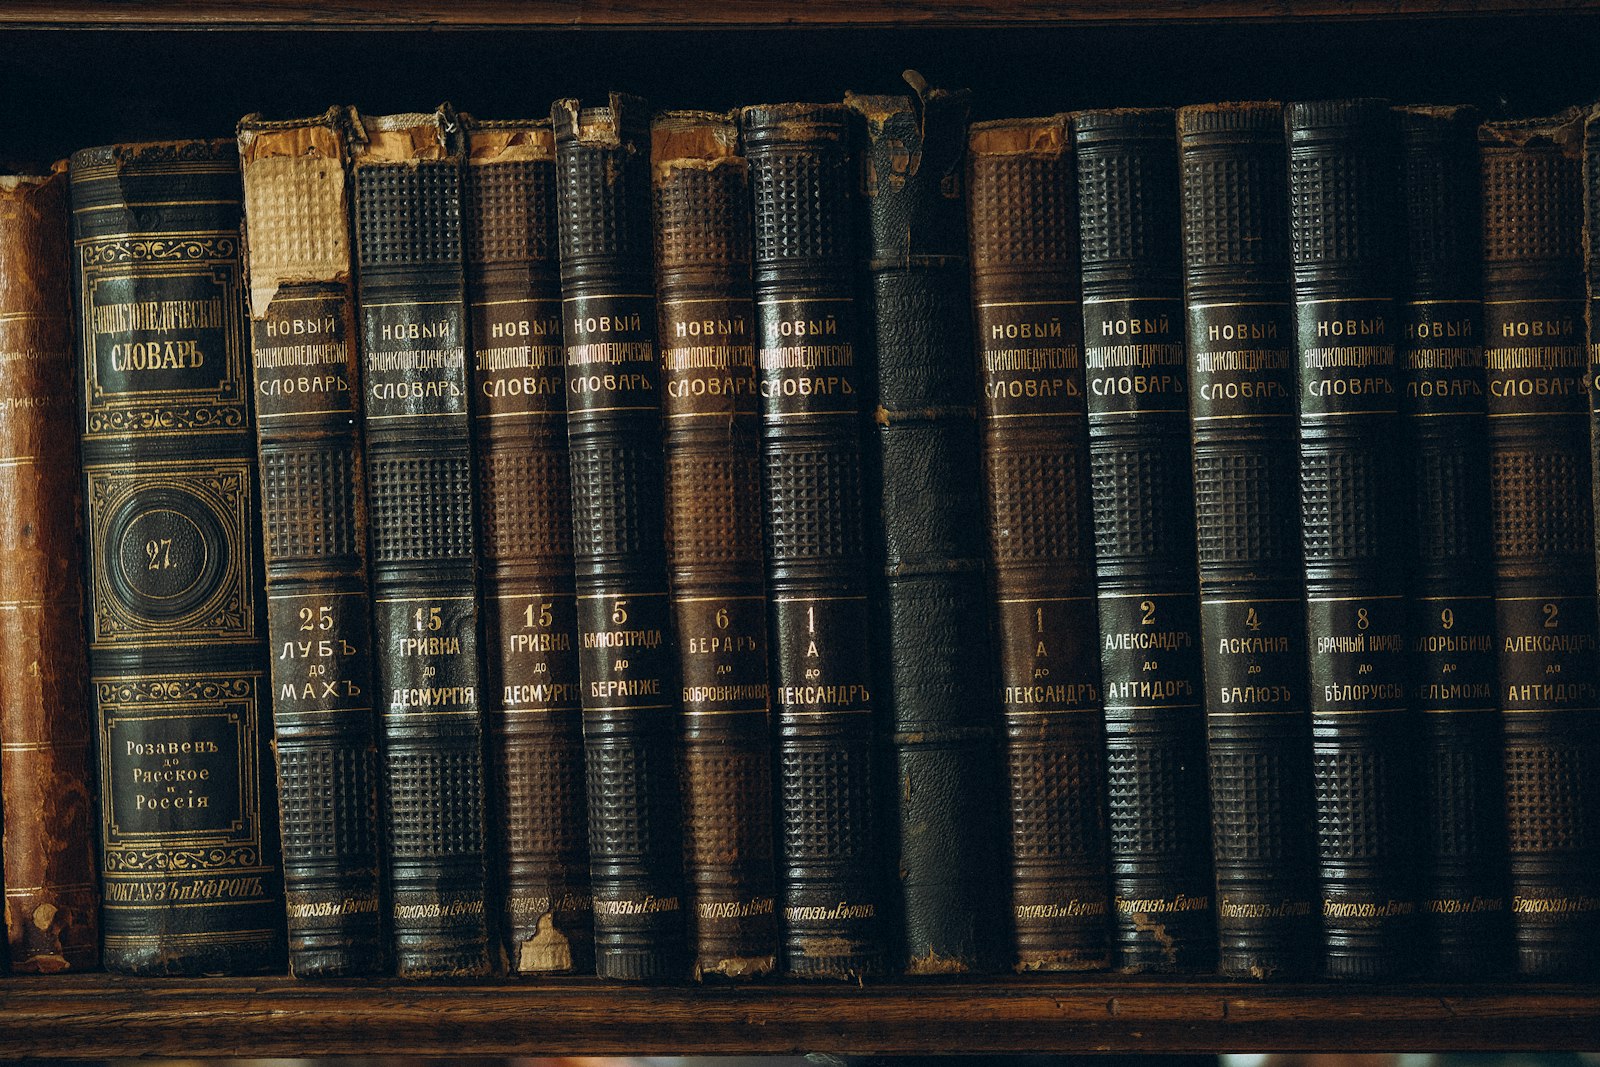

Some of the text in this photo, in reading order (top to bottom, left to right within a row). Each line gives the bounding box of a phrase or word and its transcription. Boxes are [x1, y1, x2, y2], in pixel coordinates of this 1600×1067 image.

[267, 315, 335, 337] НОВЫЙ
[382, 319, 449, 341] НОВЫЙ
[492, 316, 560, 338] НОВЫЙ
[574, 313, 641, 334] НОВЫЙ
[676, 314, 745, 338] НОВЫЙ
[768, 315, 837, 337] НОВЫЙ
[992, 317, 1061, 339] НОВЫЙ
[1103, 314, 1169, 336] НОВЫЙ
[1209, 320, 1277, 342] НОВЫЙ
[1317, 316, 1386, 337] НОВЫЙ
[1404, 319, 1473, 338] НОВЫЙ
[1503, 316, 1573, 338] НОВЫЙ
[112, 340, 204, 372] СЛОВАРЬ
[368, 346, 464, 373] ЭНЦИКЛОПЕДИЧЕСКІЙ
[758, 342, 854, 371] НЦИКЛОПЕДИЧЕСКІЙ
[1086, 341, 1184, 370] ЭНЦИКЛОПЕДИЧЕСКІЙ
[146, 538, 177, 570] 27.
[300, 606, 334, 631] 25
[413, 607, 442, 631] 15
[523, 603, 553, 628] 15
[612, 601, 628, 625] 5
[715, 607, 729, 630] 6
[806, 606, 815, 633] 1
[1035, 607, 1044, 634] 1
[1140, 600, 1156, 625] 2
[1246, 607, 1262, 631] 4
[1357, 607, 1369, 630] 8
[1441, 607, 1454, 630] 9
[1542, 603, 1559, 629] 2
[280, 640, 357, 659] ЛУБЪ
[400, 637, 461, 657] ГРИВНА
[511, 633, 570, 653] ГРИВНА
[584, 630, 662, 650] БАЛЮСТРАДА
[689, 635, 757, 654] БЕРАРЪ
[807, 640, 820, 657] А
[1036, 640, 1048, 657] А
[1105, 631, 1192, 651] АЛЕКСАНДРЪ
[1219, 636, 1288, 654] АСКАНІЯ
[1317, 633, 1364, 654] БРАЧНЫЙ
[1504, 634, 1596, 653] АЛЕКСАНДРЪ
[309, 664, 325, 677] до
[423, 665, 435, 677] до
[534, 662, 547, 673] до
[614, 659, 629, 671] до
[717, 664, 732, 675] до
[805, 668, 820, 680] до
[1034, 667, 1050, 679] до
[1142, 661, 1158, 672] до
[1248, 665, 1262, 675] до
[1358, 663, 1373, 675] до
[1442, 663, 1457, 674] до
[1545, 664, 1561, 675] до
[281, 680, 361, 701] МАХЪ
[391, 687, 474, 710] ДЕСМУРГІЯ
[591, 679, 661, 698] БЕРАНЖЕ
[682, 684, 769, 703] БОБРОВНИКОВА
[1109, 680, 1193, 701] АНТИДОРЪ
[1221, 686, 1291, 704] БАЛЮЗЪ
[1508, 684, 1597, 703] АНТИДОРЪ
[127, 740, 219, 755] Розавенъ
[163, 758, 179, 767] до
[133, 768, 210, 783] Рясское
[136, 789, 210, 810] Россія
[105, 880, 178, 901] БРОКГАУЗЪ
